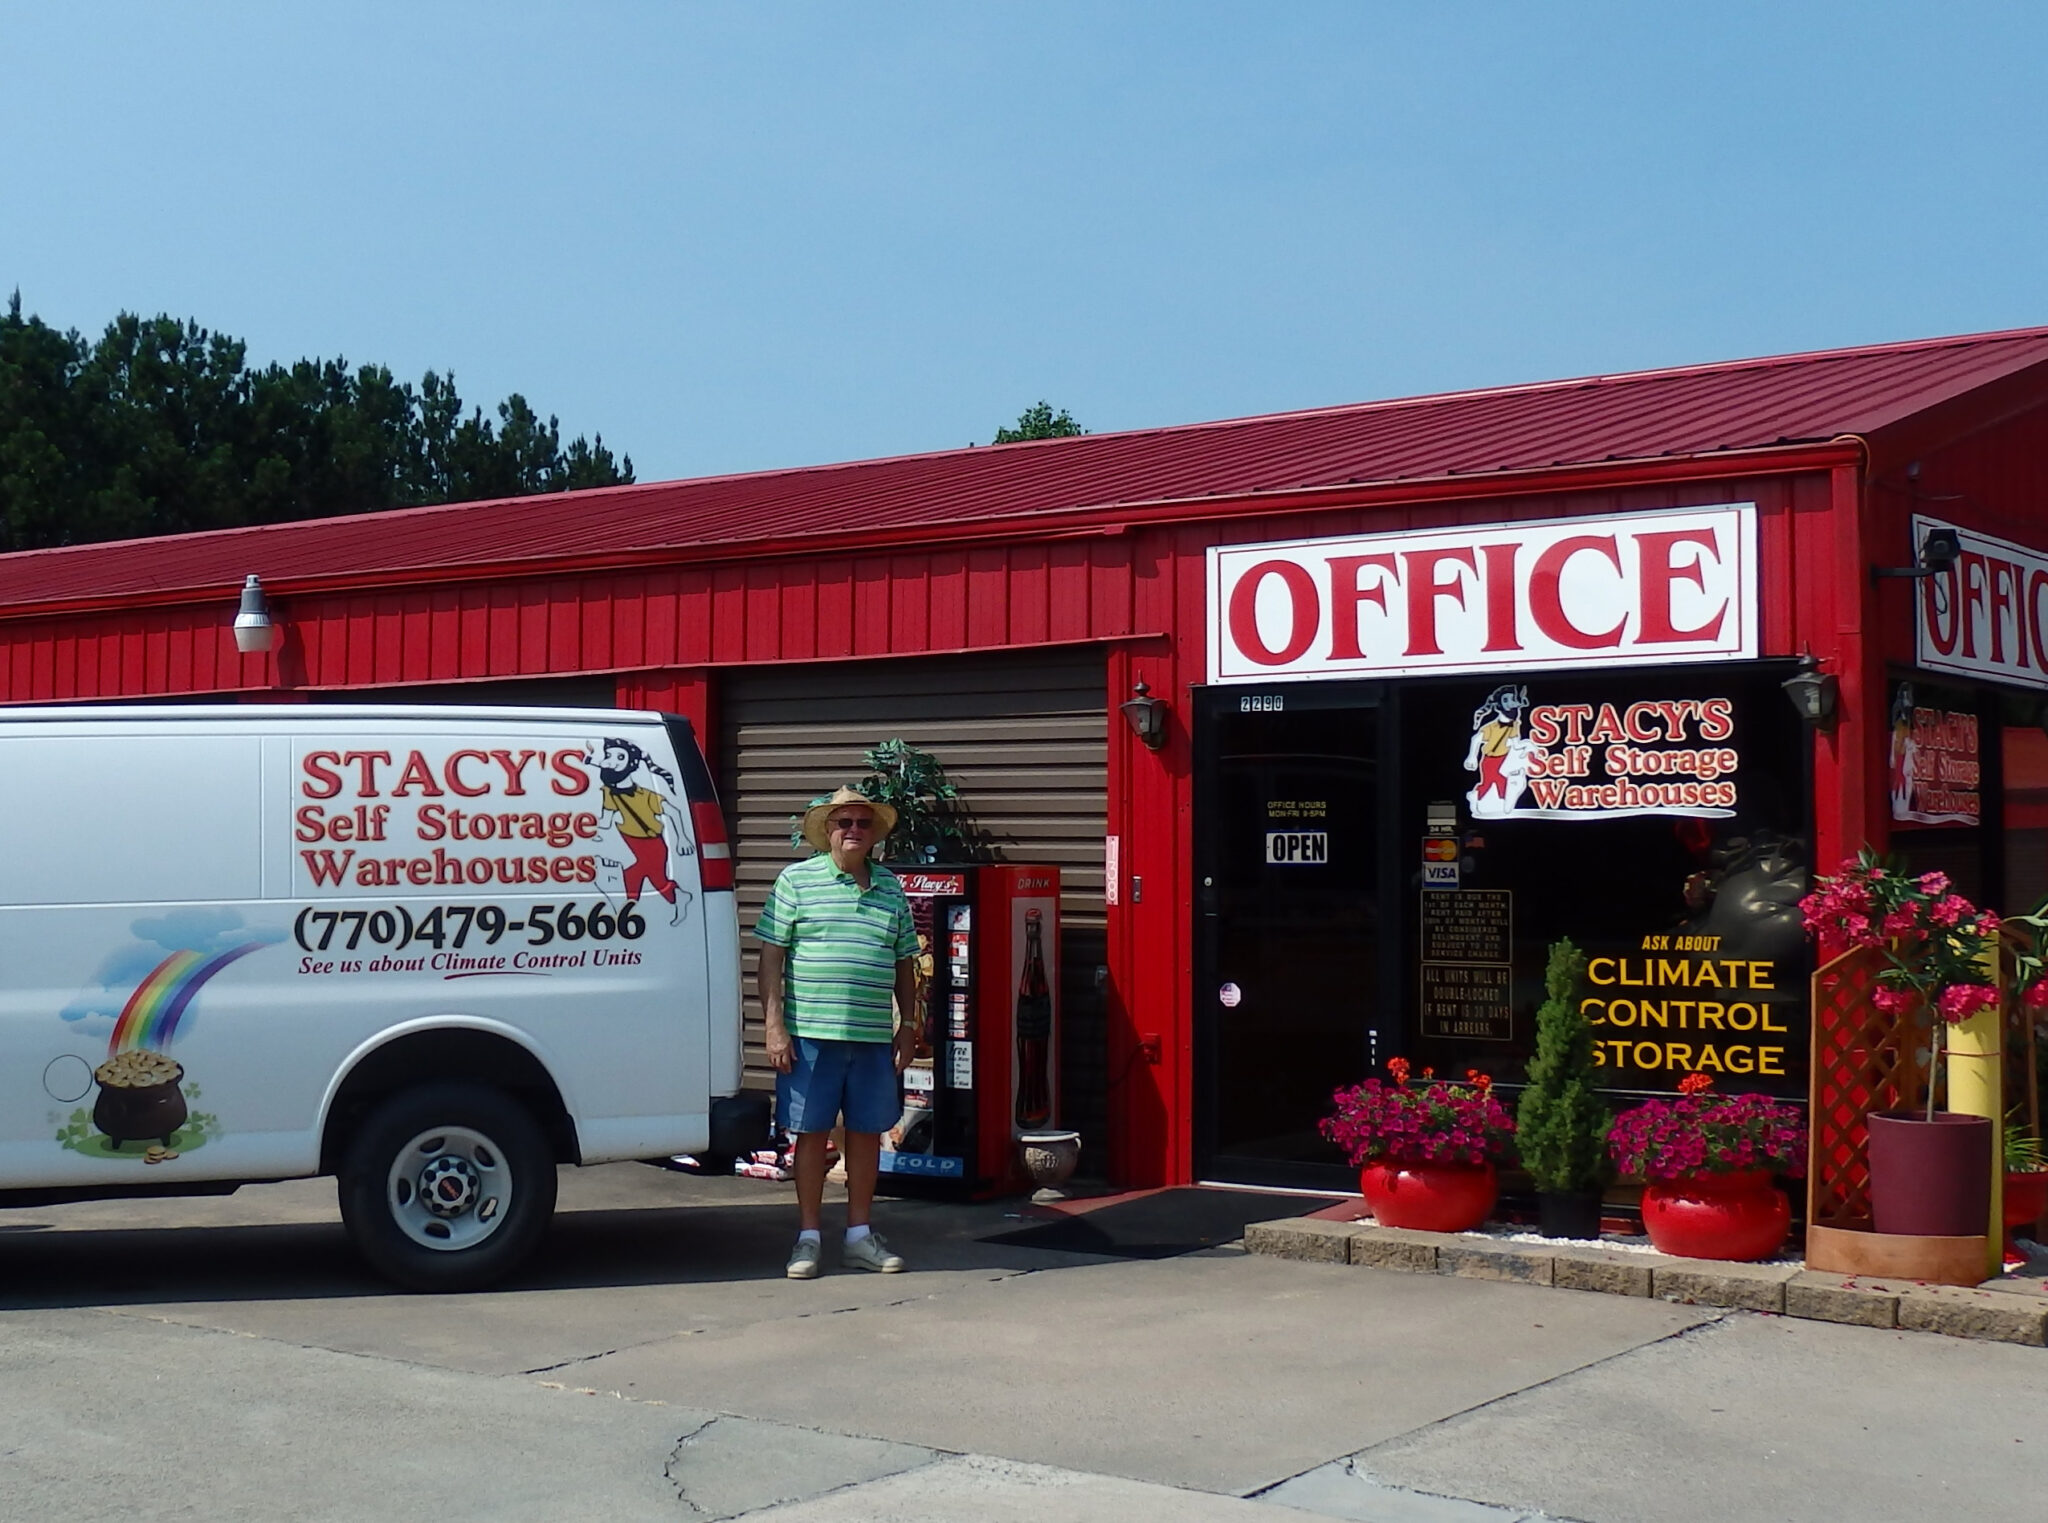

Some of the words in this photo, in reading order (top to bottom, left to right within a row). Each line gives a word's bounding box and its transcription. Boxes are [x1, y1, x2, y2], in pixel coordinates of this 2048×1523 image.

[1228, 527, 1728, 667] OFFICE
[1241, 696, 1284, 712] 2290
[1529, 698, 1733, 746] STACY'S
[302, 749, 590, 799] STACY'S
[1528, 746, 1592, 777] Self
[1605, 743, 1738, 780] Storage
[1267, 801, 1296, 809] OFFICE
[1298, 801, 1327, 809] HOURS
[1530, 777, 1736, 809] Warehouses
[296, 805, 391, 842] Self
[416, 803, 598, 848] Storage
[1273, 834, 1325, 861] OPEN
[299, 848, 597, 888] Warehouses
[1107, 841, 1117, 901] 138
[1428, 867, 1456, 878] VISA
[910, 875, 952, 892] Stacy's
[1018, 878, 1049, 890] DRINK
[294, 902, 646, 951] (770)479-5666
[1641, 935, 1670, 950] ASK
[1675, 935, 1722, 952] ABOUT
[298, 956, 334, 974] See
[340, 959, 362, 972] us
[369, 953, 425, 973] about
[431, 950, 506, 971] Climate
[512, 948, 586, 968] Control
[592, 947, 643, 966] Units
[1588, 957, 1775, 990] CLIMATE
[1425, 969, 1440, 982] ALL
[1444, 969, 1469, 983] UNITS
[1497, 971, 1507, 984] BE
[1424, 1003, 1432, 1016] IF
[1436, 1003, 1457, 1017] RENT
[1488, 1005, 1509, 1019] DAYS
[1580, 998, 1788, 1032] CONTROL
[1440, 1021, 1449, 1033] IN
[1592, 1040, 1785, 1075] STORAGE
[896, 1156, 956, 1170] COLD
